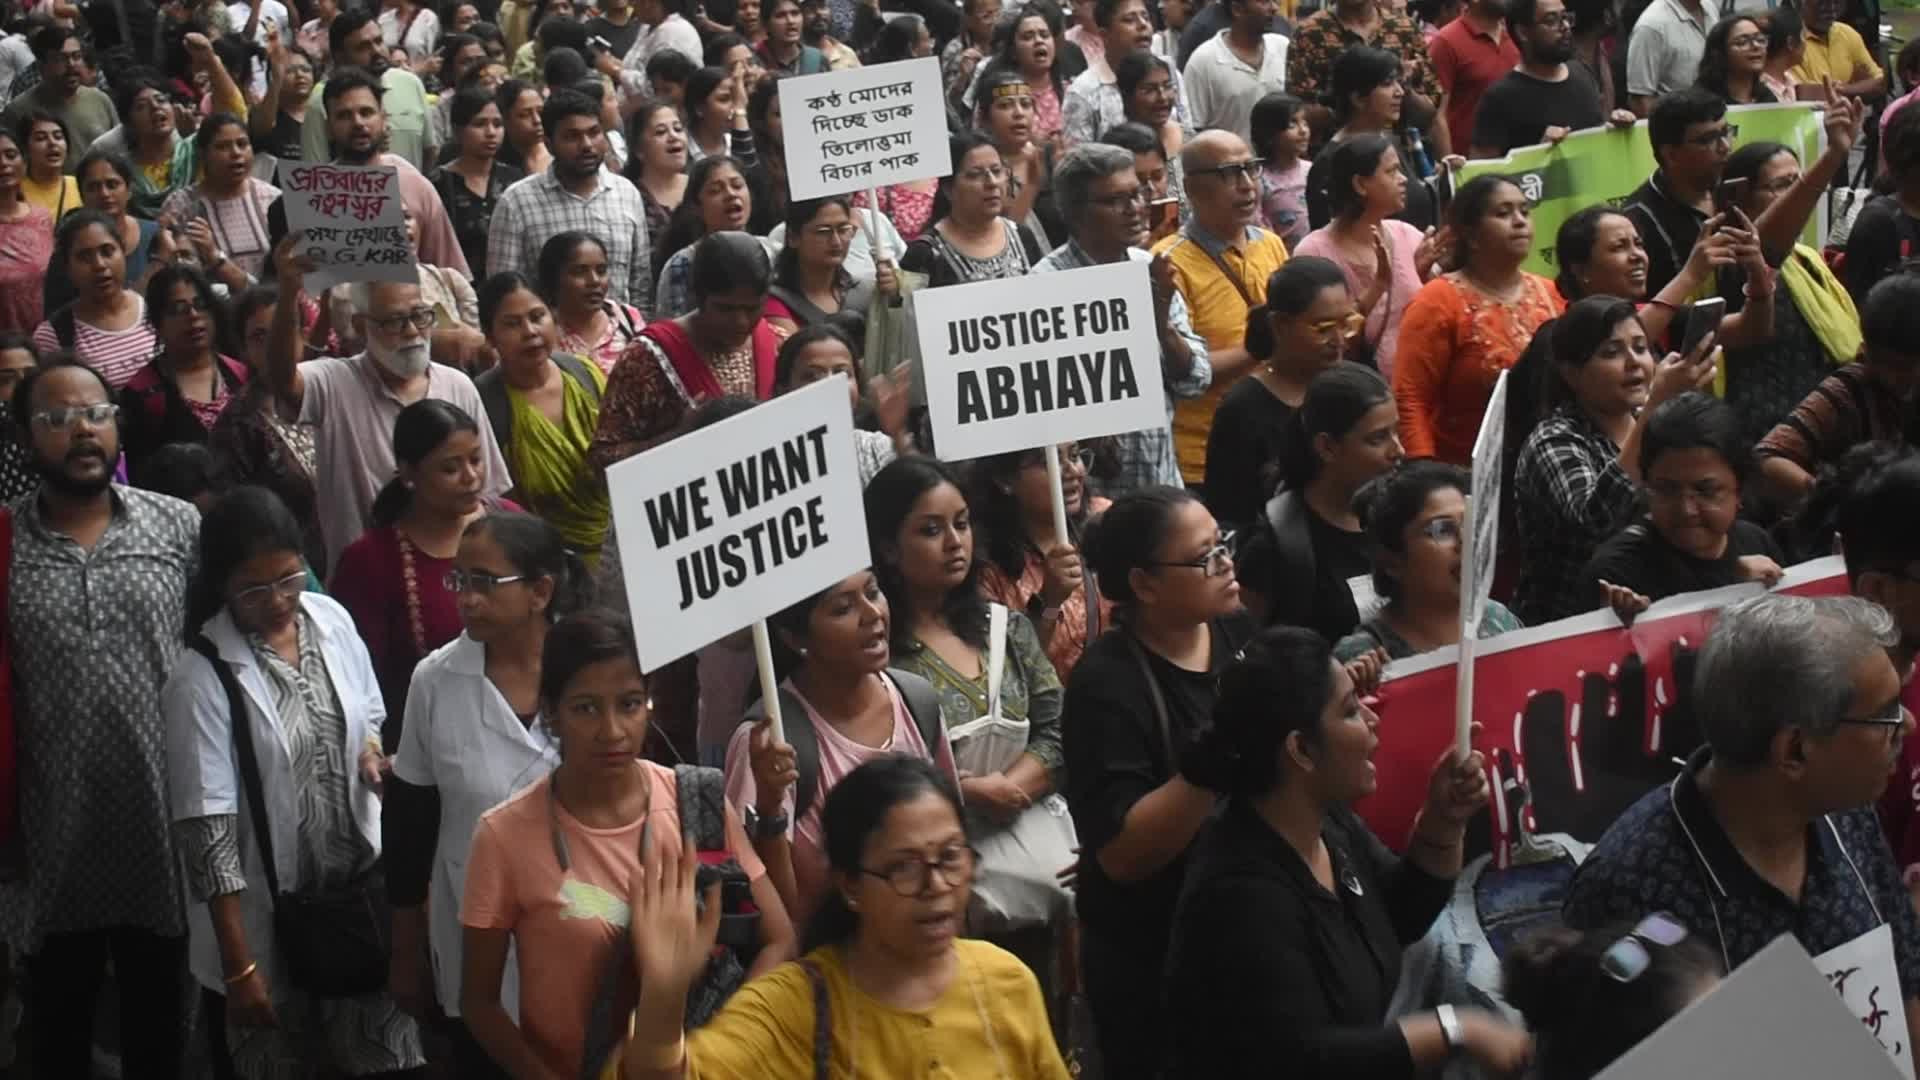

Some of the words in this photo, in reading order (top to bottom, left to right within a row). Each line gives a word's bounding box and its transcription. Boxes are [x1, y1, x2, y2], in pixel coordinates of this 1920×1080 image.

[848, 81, 913, 105] মোদের
[812, 113, 868, 134] দিচ্ছে
[872, 104, 913, 123] ডাক
[821, 131, 912, 159] তিলোত্তমা
[286, 165, 396, 193] প্রতিবাদের
[821, 161, 872, 183] বিচার
[879, 152, 919, 170] পাক
[308, 193, 349, 219] নতুন
[948, 306, 1067, 355] JUSTICE
[1073, 298, 1130, 337] FOR
[957, 348, 1140, 424] ABHAYA
[644, 477, 714, 550] WE
[716, 424, 828, 518] WANT
[676, 495, 829, 611] JUSTICE
